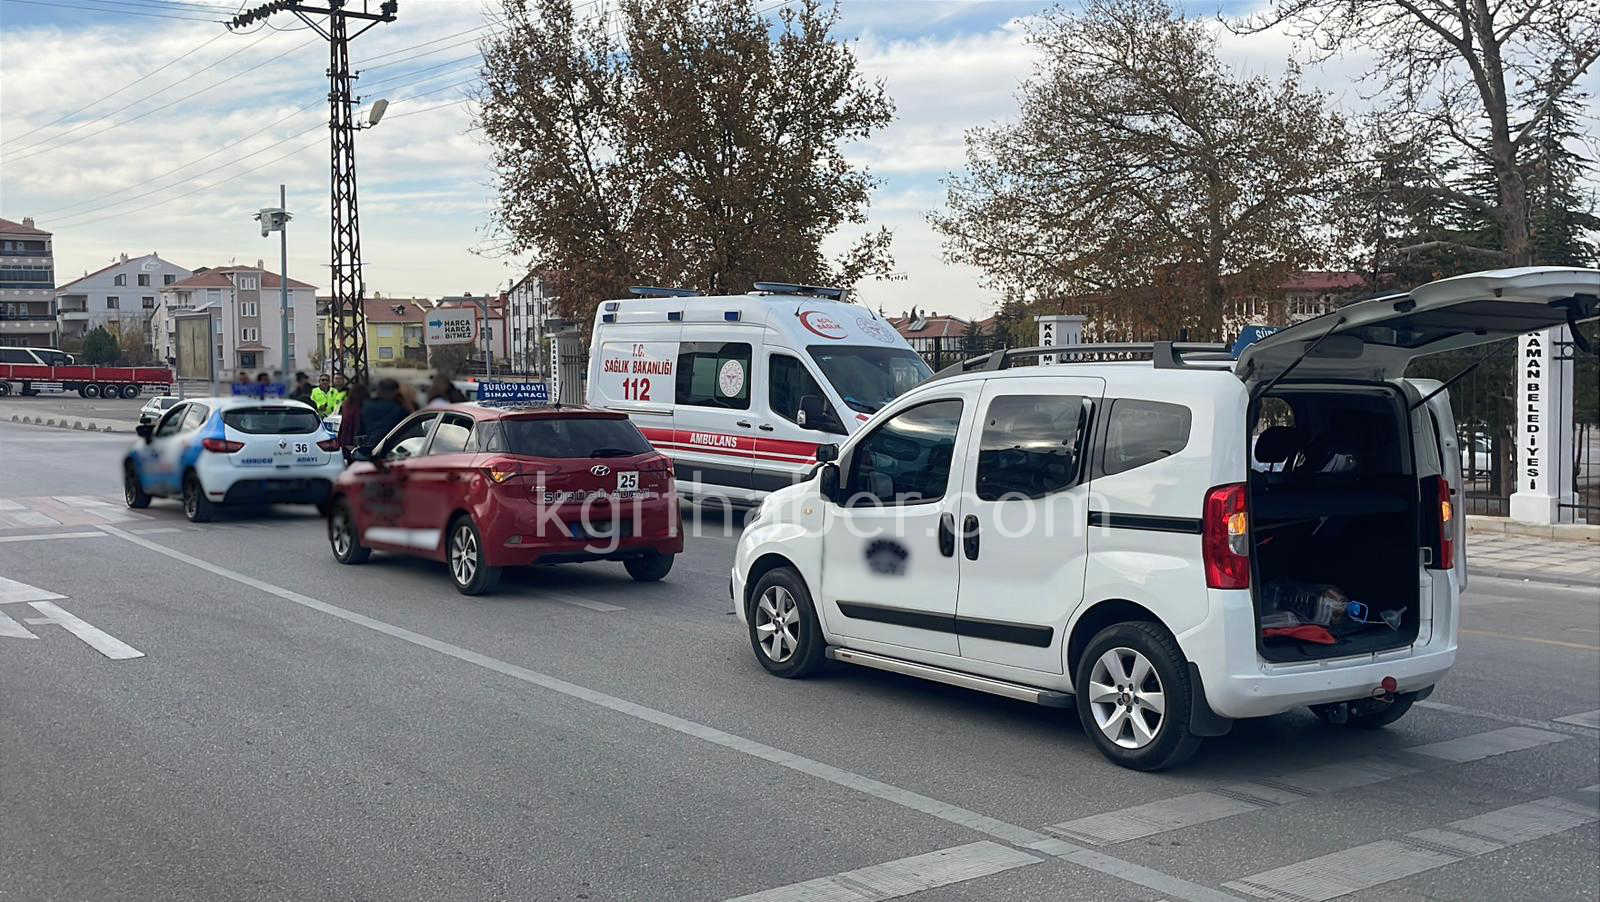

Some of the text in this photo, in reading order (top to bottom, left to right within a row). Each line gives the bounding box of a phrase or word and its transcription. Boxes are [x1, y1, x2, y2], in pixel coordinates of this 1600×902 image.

[632, 343, 645, 358] T.C.
[604, 357, 673, 376] SAĞLIK BAKANLIĞI
[622, 377, 651, 401] 112
[689, 432, 738, 448] AMBULANS
[295, 443, 309, 453] 36
[620, 474, 637, 489] 25
